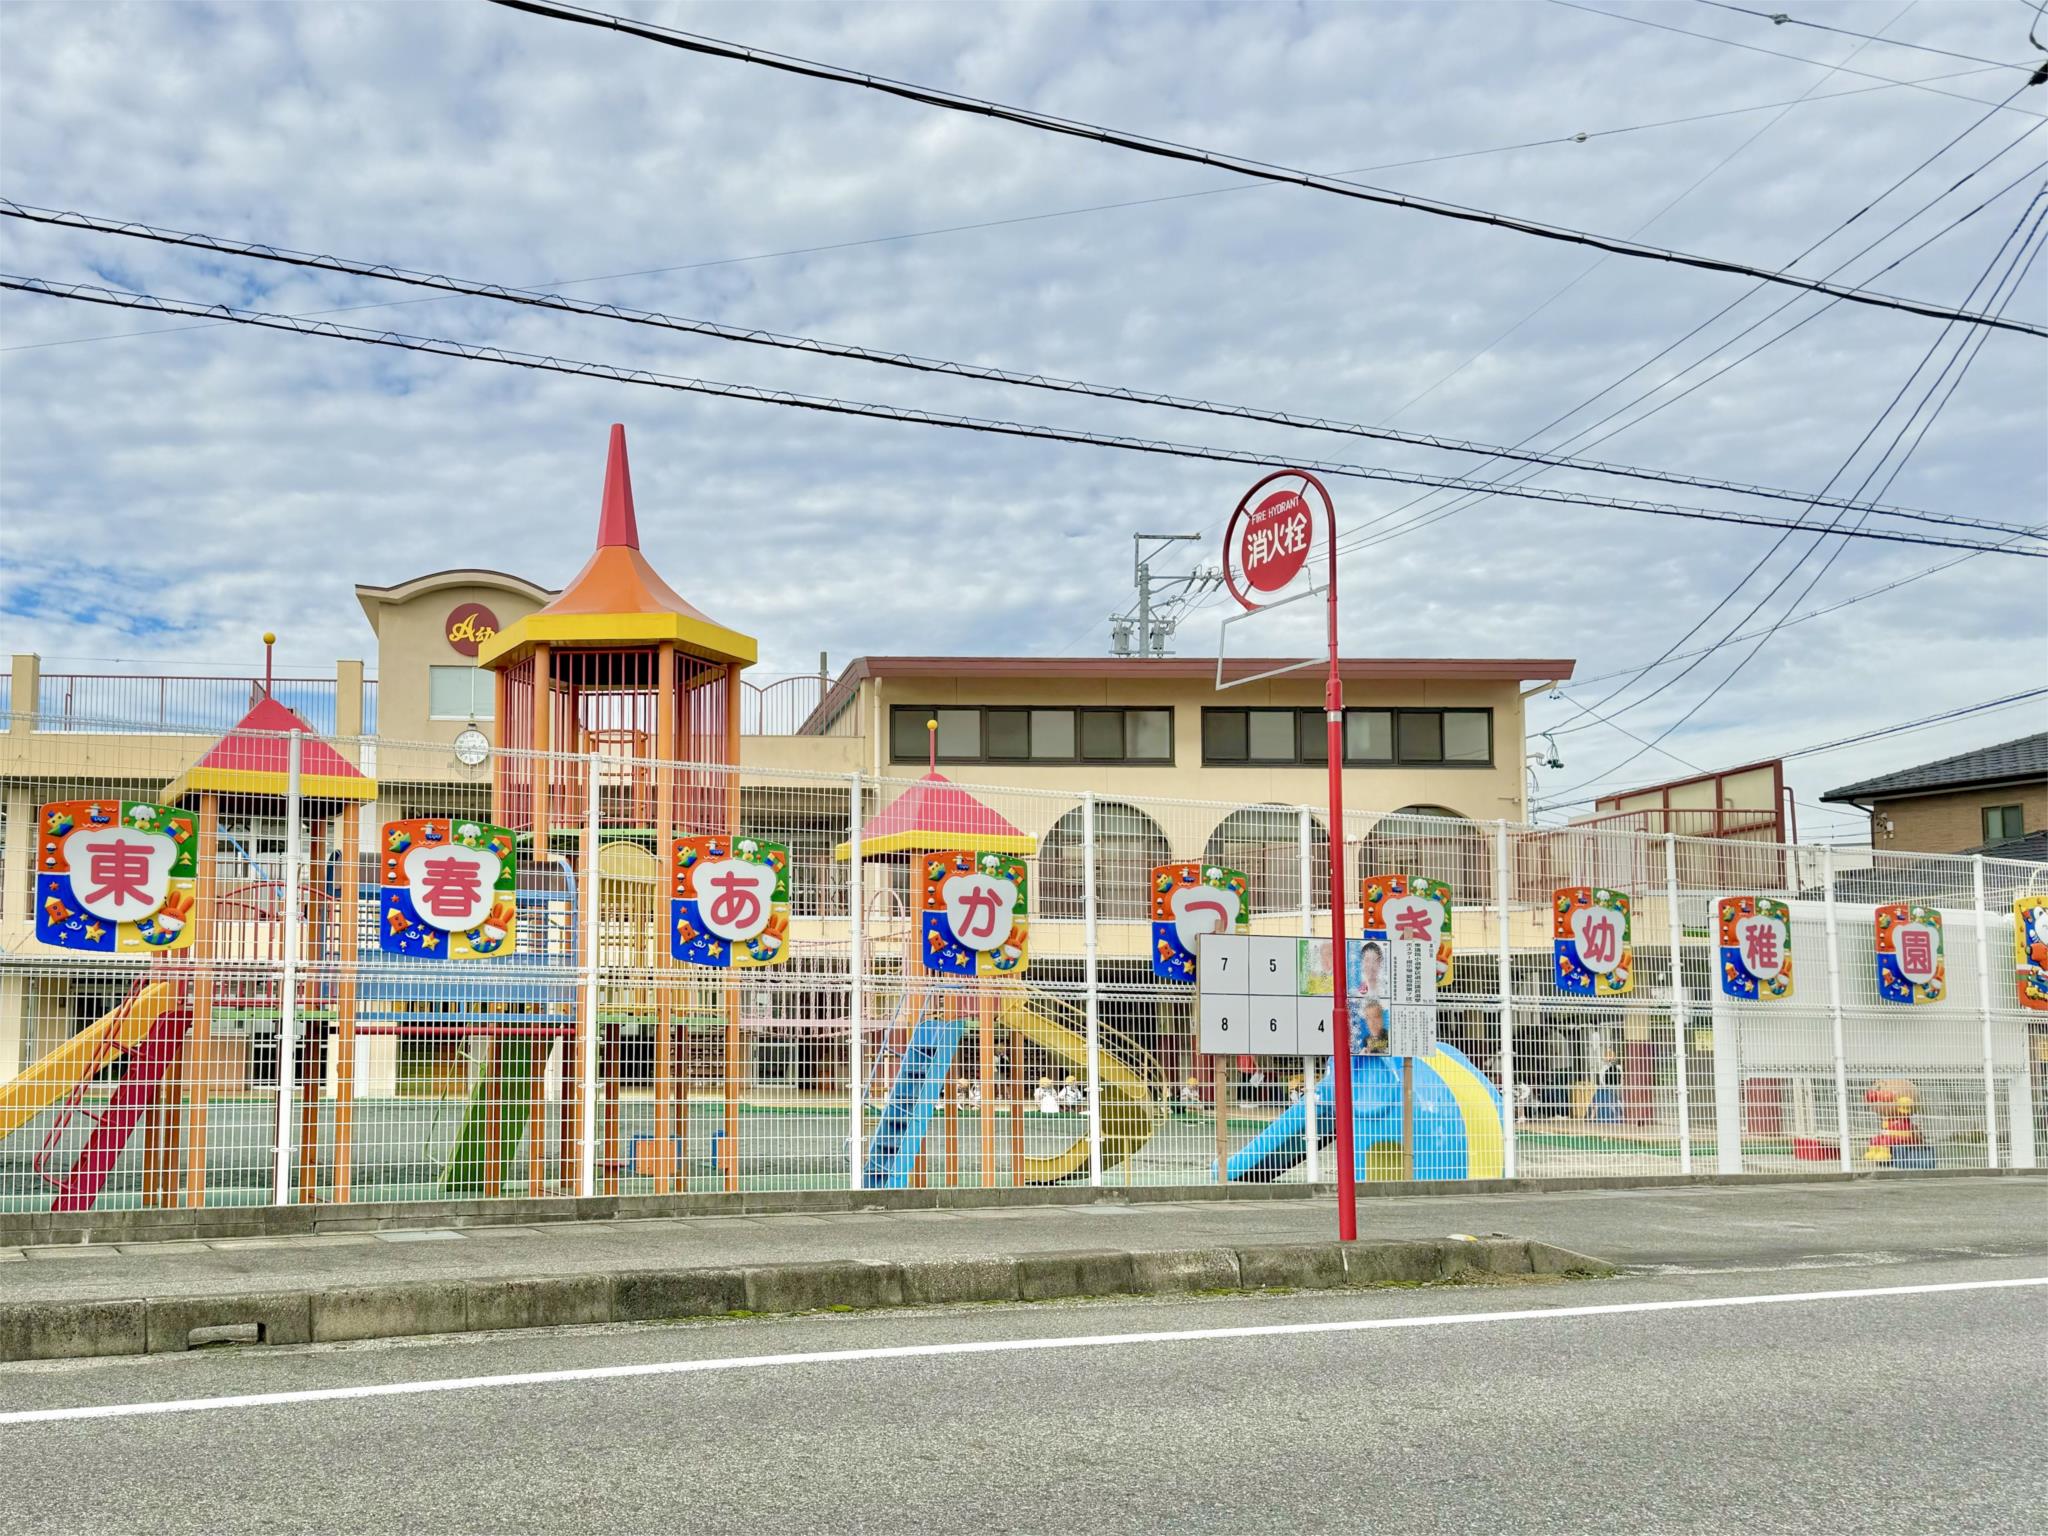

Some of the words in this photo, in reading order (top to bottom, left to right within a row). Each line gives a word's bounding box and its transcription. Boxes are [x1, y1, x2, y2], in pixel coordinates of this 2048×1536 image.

[1251, 510, 1267, 525] FIRE
[1268, 496, 1300, 518] HYDRANT
[1247, 512, 1308, 571] 消火栓
[85, 839, 155, 907] 東
[421, 857, 482, 917] 春
[710, 871, 761, 928] あ
[957, 886, 1003, 938] か
[1395, 906, 1432, 941] き
[1582, 914, 1616, 962] 幼
[1221, 957, 1229, 971] 7
[1269, 958, 1277, 972] 5
[1745, 924, 1779, 969] 稚
[1902, 930, 1932, 975] 園
[1221, 1017, 1229, 1031] 8
[1269, 1018, 1277, 1032] 6
[1317, 1019, 1325, 1033] 4
